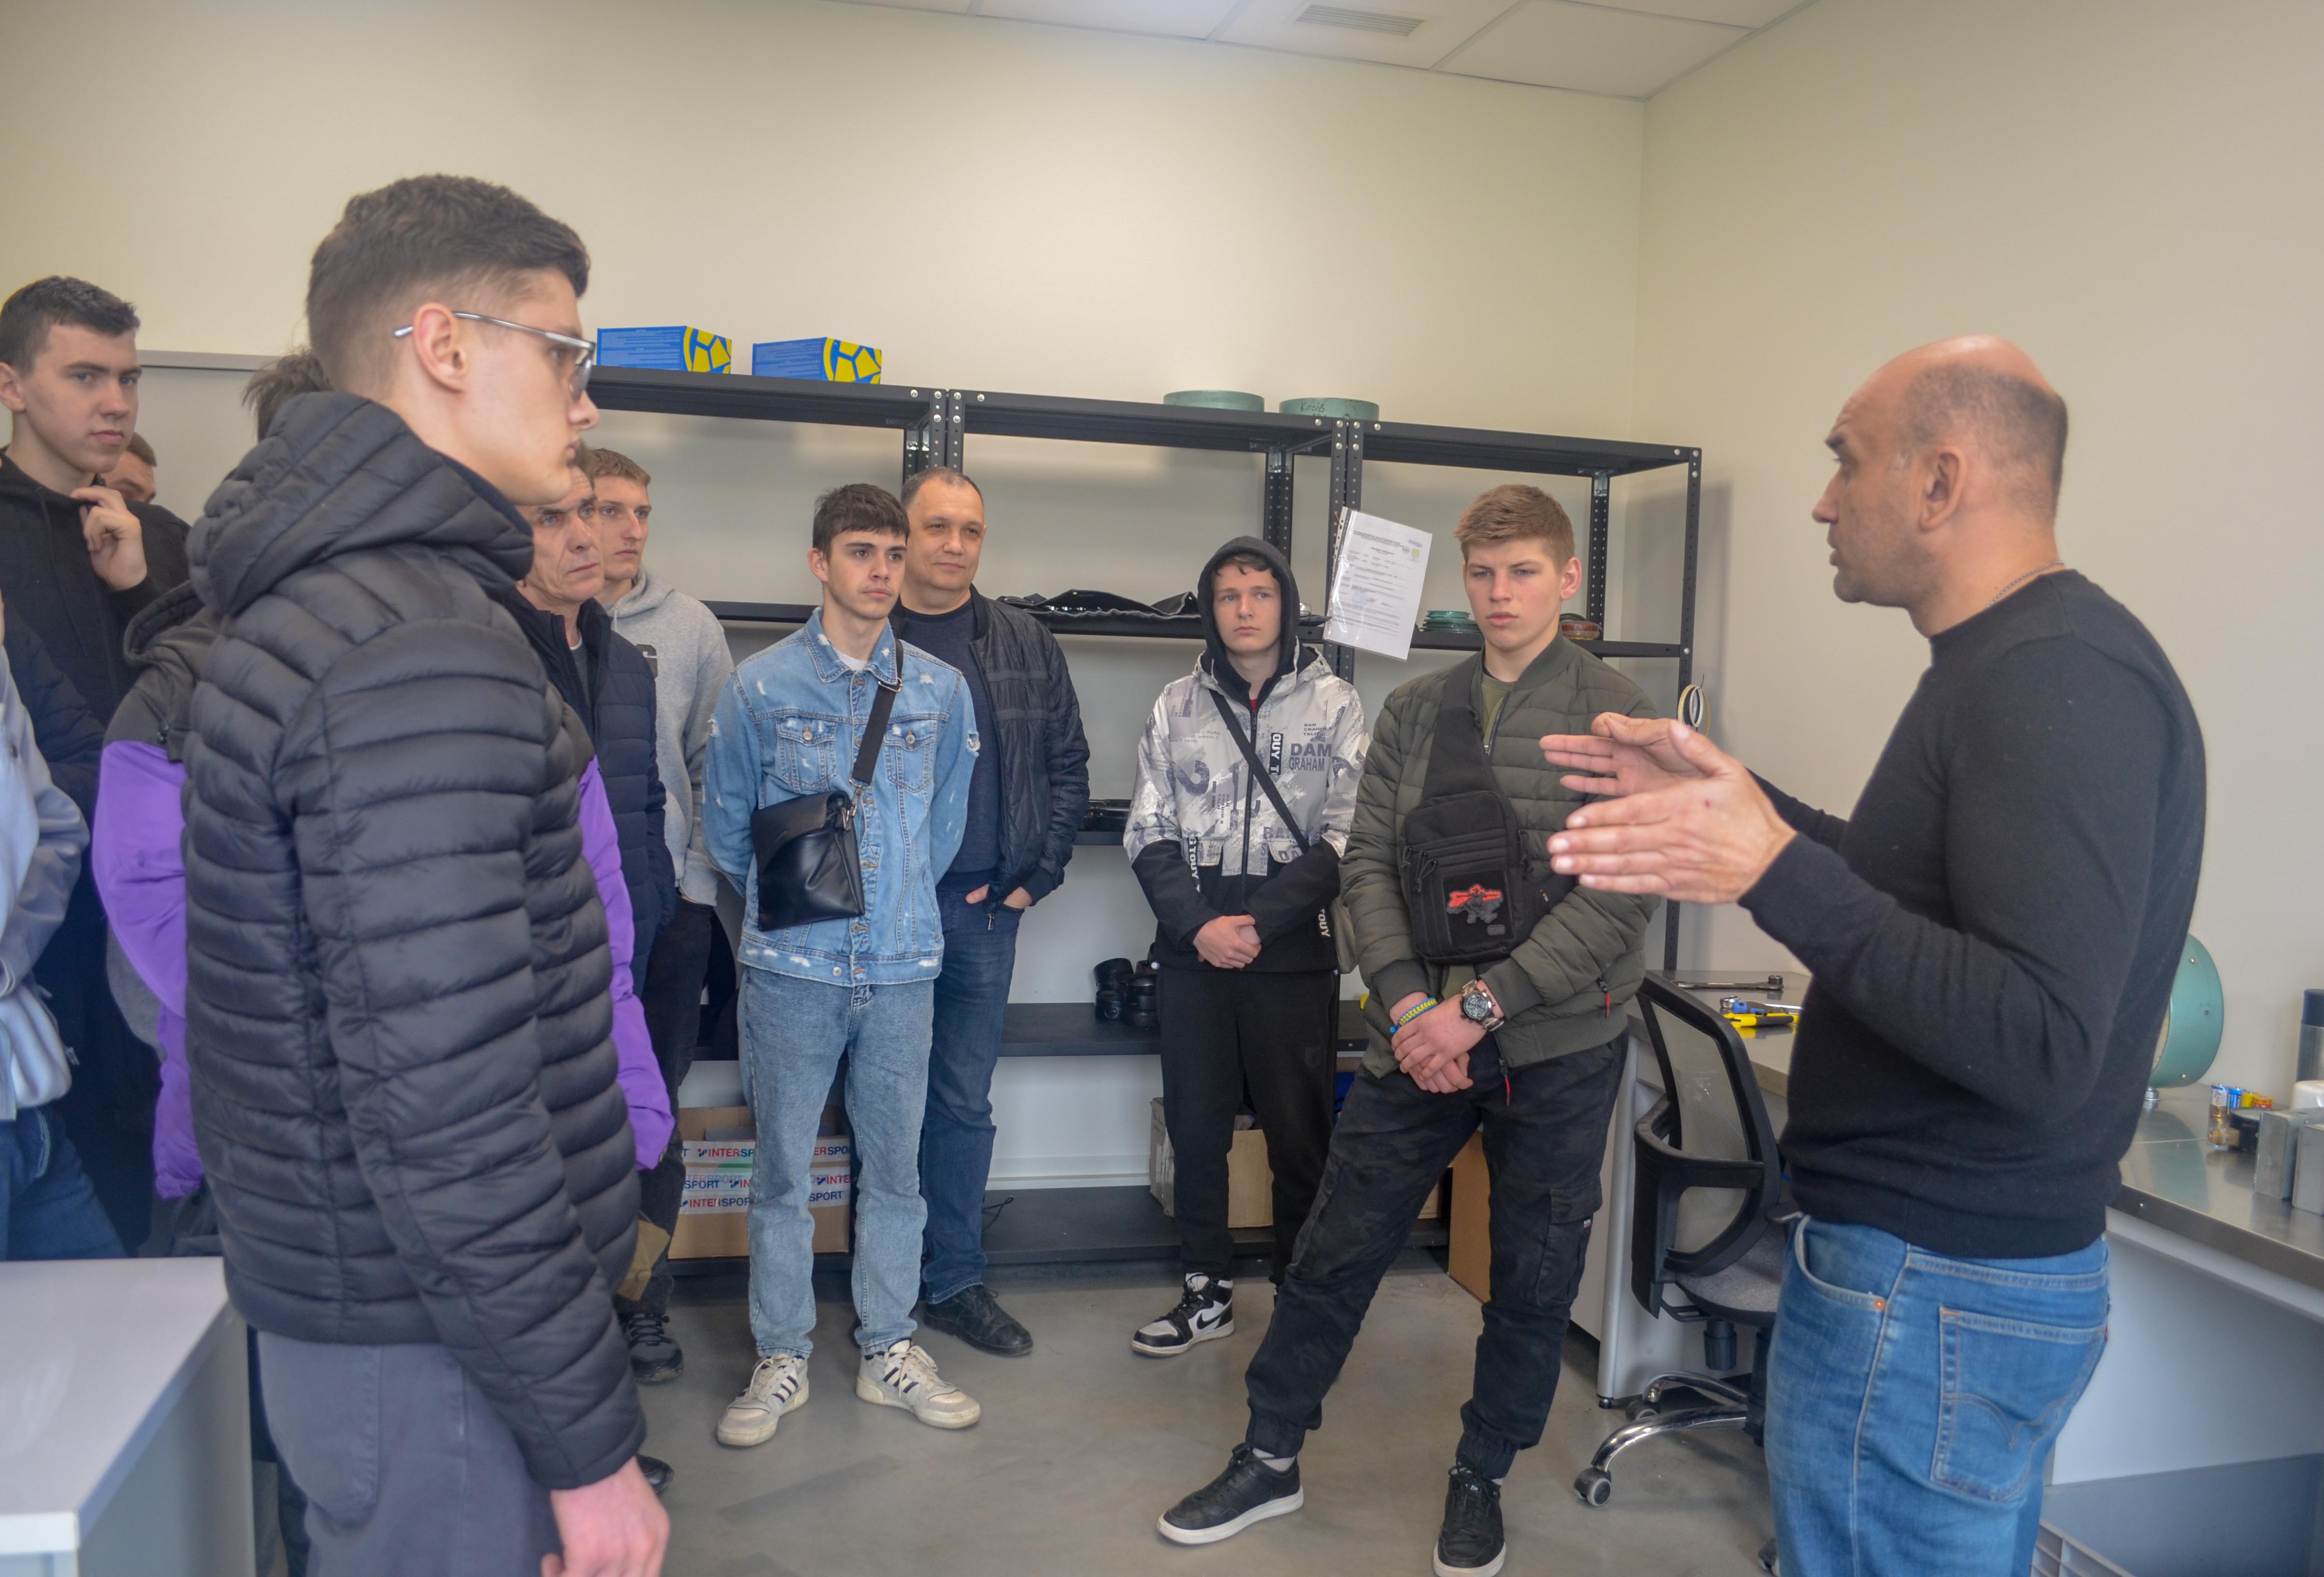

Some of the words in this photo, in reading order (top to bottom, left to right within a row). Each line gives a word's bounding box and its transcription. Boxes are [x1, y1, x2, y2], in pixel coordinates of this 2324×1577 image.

[1291, 743, 1332, 757] DAM
[1289, 757, 1325, 772] GRAHAM
[814, 1146, 851, 1156] ERSPO
[684, 1180, 719, 1189] SPORT
